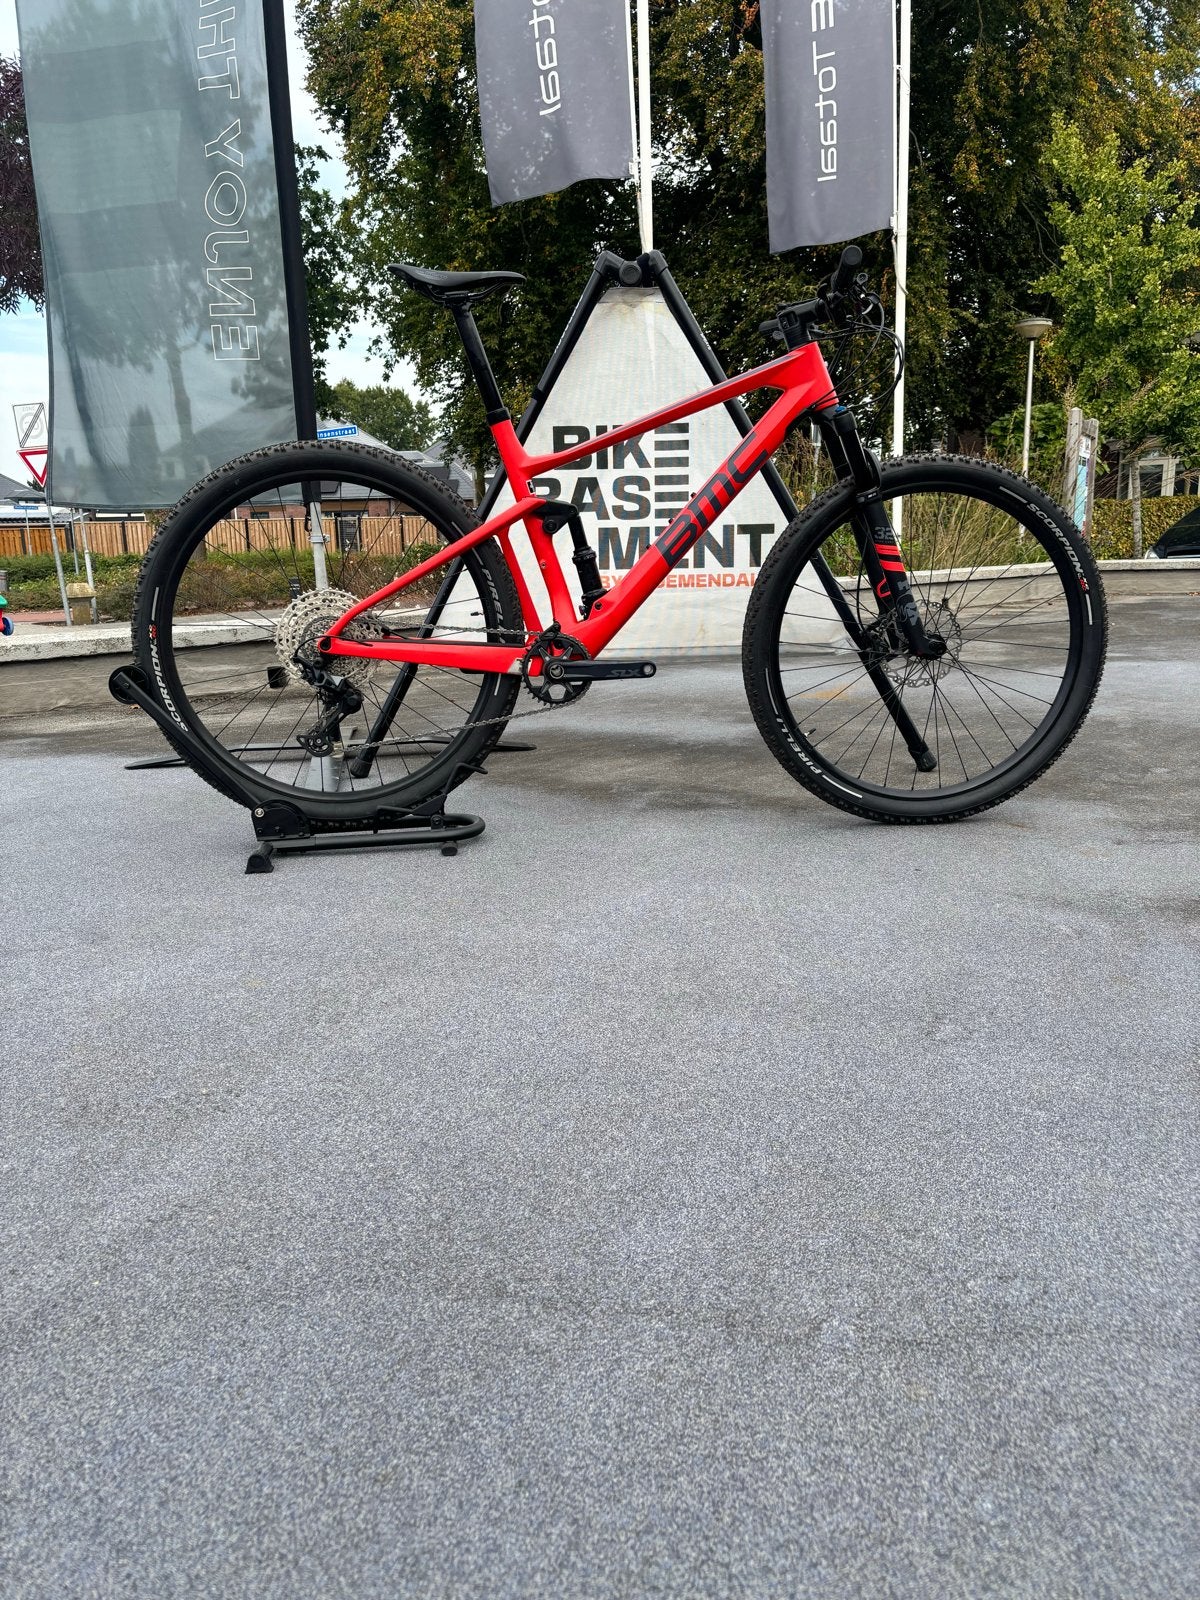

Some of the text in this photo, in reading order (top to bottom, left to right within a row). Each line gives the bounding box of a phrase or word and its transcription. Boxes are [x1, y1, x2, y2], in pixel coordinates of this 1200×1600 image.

[655, 431, 768, 567] BMC
[598, 523, 775, 570] MNT
[1027, 503, 1084, 574] SCORPION
[776, 718, 822, 775] PIRELLI
